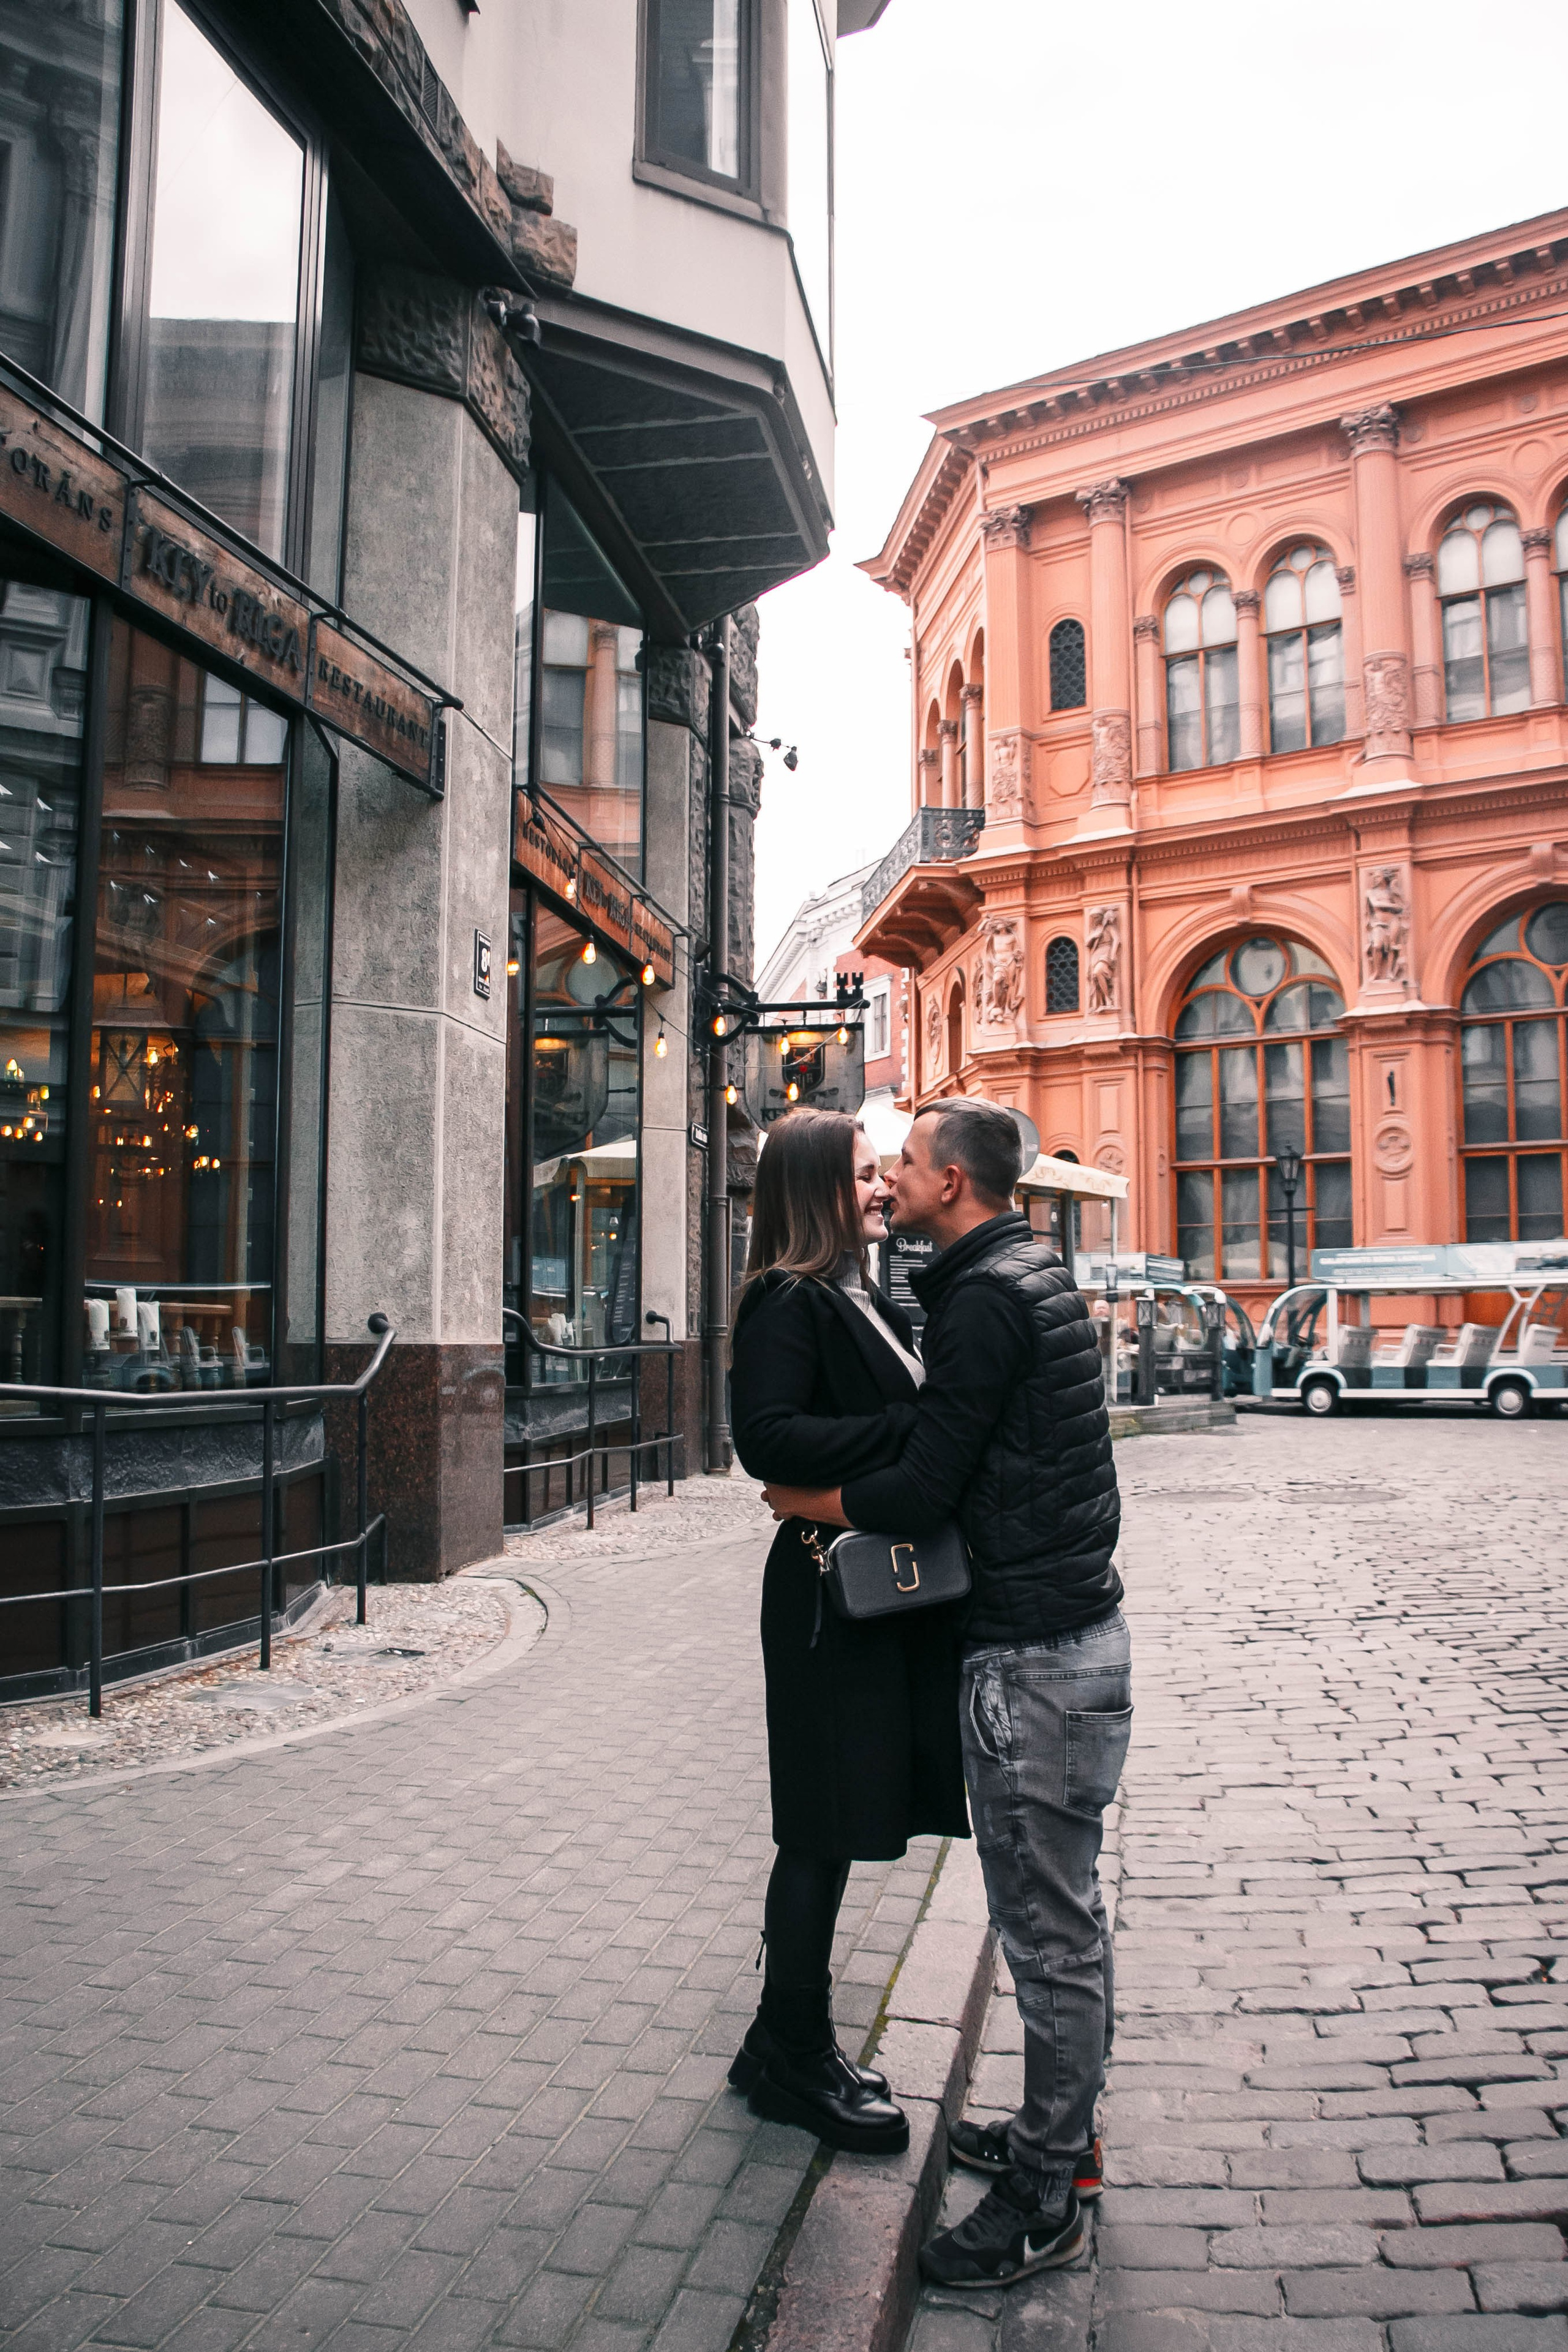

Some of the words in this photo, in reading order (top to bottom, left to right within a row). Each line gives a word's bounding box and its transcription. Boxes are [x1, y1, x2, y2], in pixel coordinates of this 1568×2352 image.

[0, 434, 113, 533] ORĀNS
[143, 525, 214, 605] KEY
[210, 578, 228, 615] to
[229, 586, 303, 673] RIGA
[318, 657, 430, 748] RESTAURANT
[896, 1238, 933, 1254] Breakfast
